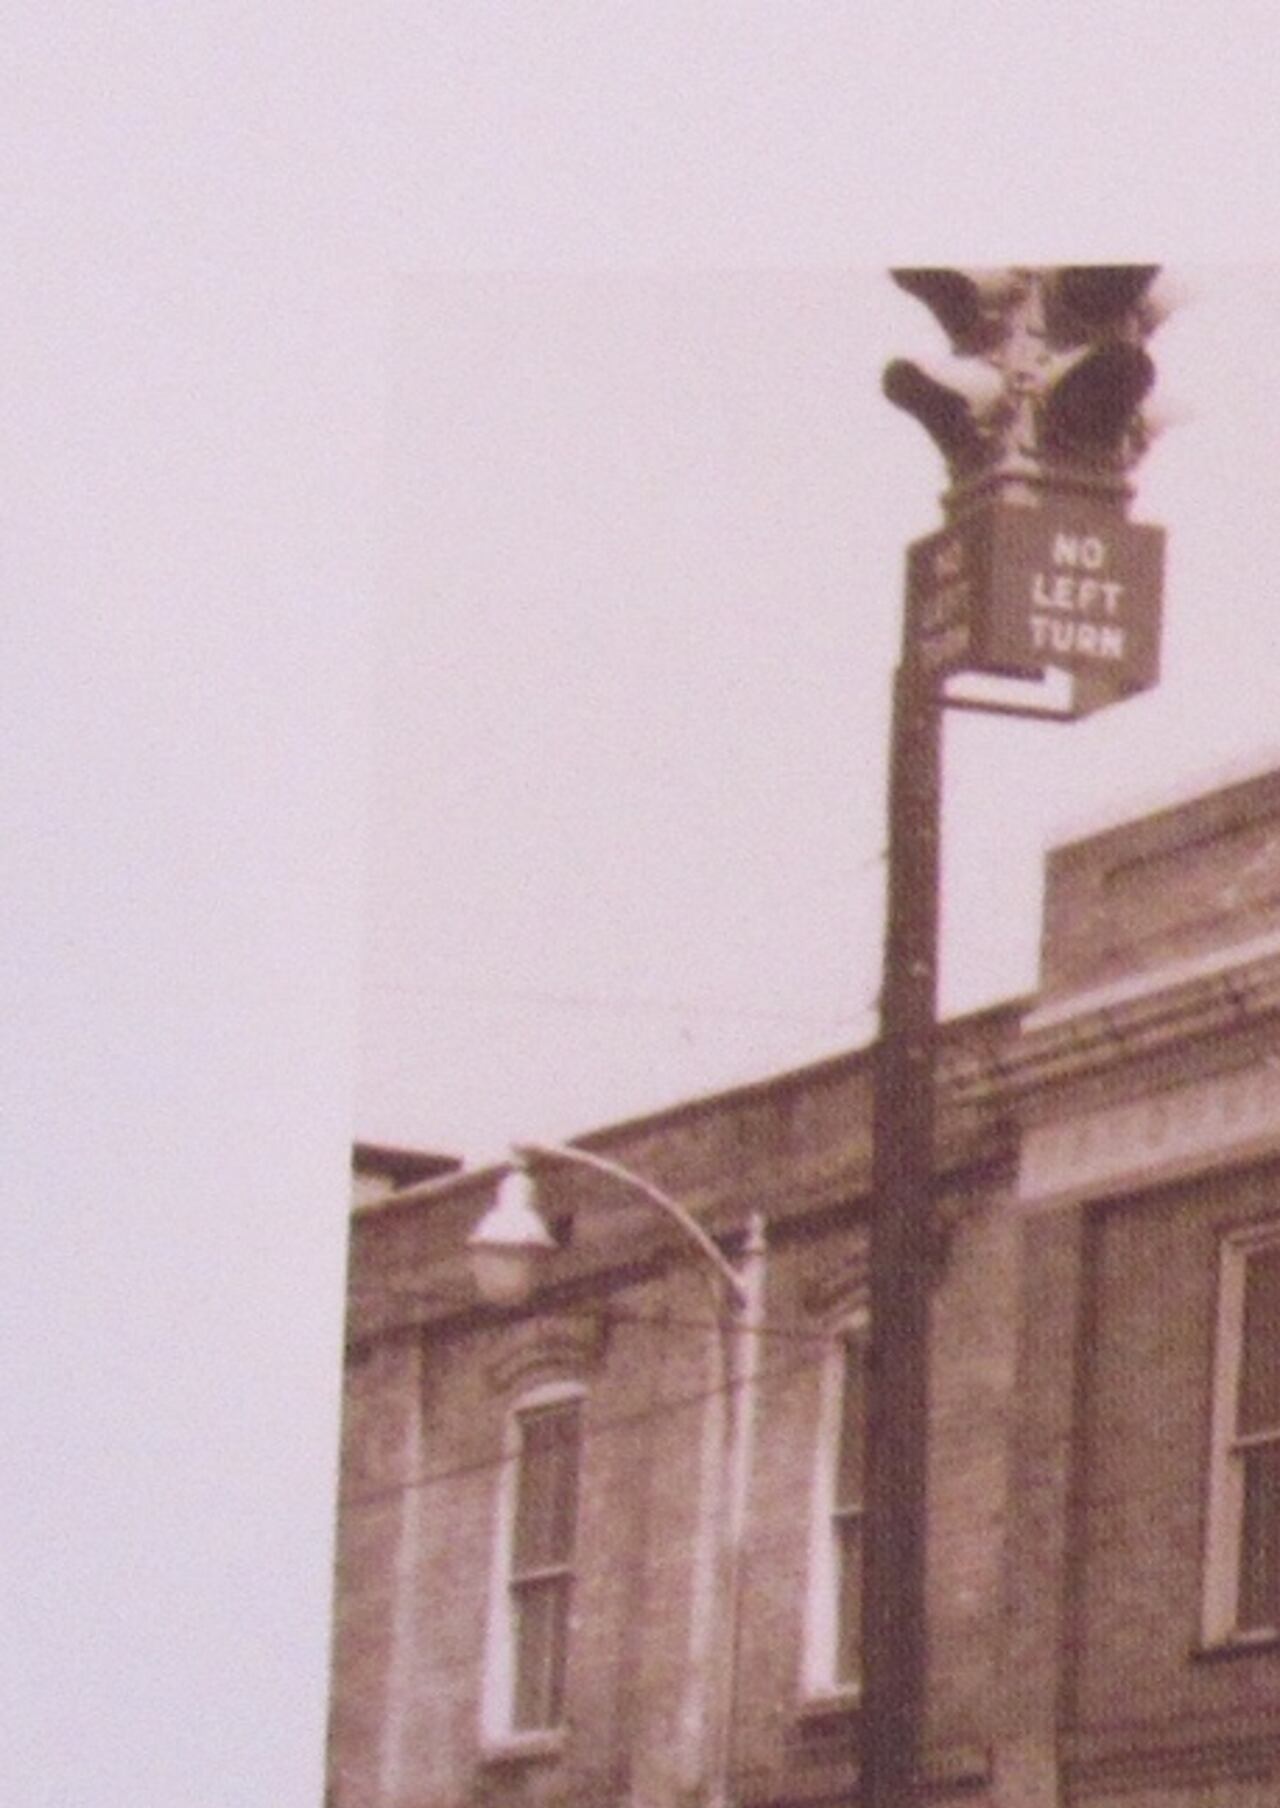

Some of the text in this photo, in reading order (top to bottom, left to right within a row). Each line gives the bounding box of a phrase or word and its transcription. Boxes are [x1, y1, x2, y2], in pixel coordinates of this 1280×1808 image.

[1052, 533, 1110, 569] NO
[1032, 573, 1124, 616] LEFT
[1029, 616, 1124, 659] TURN
